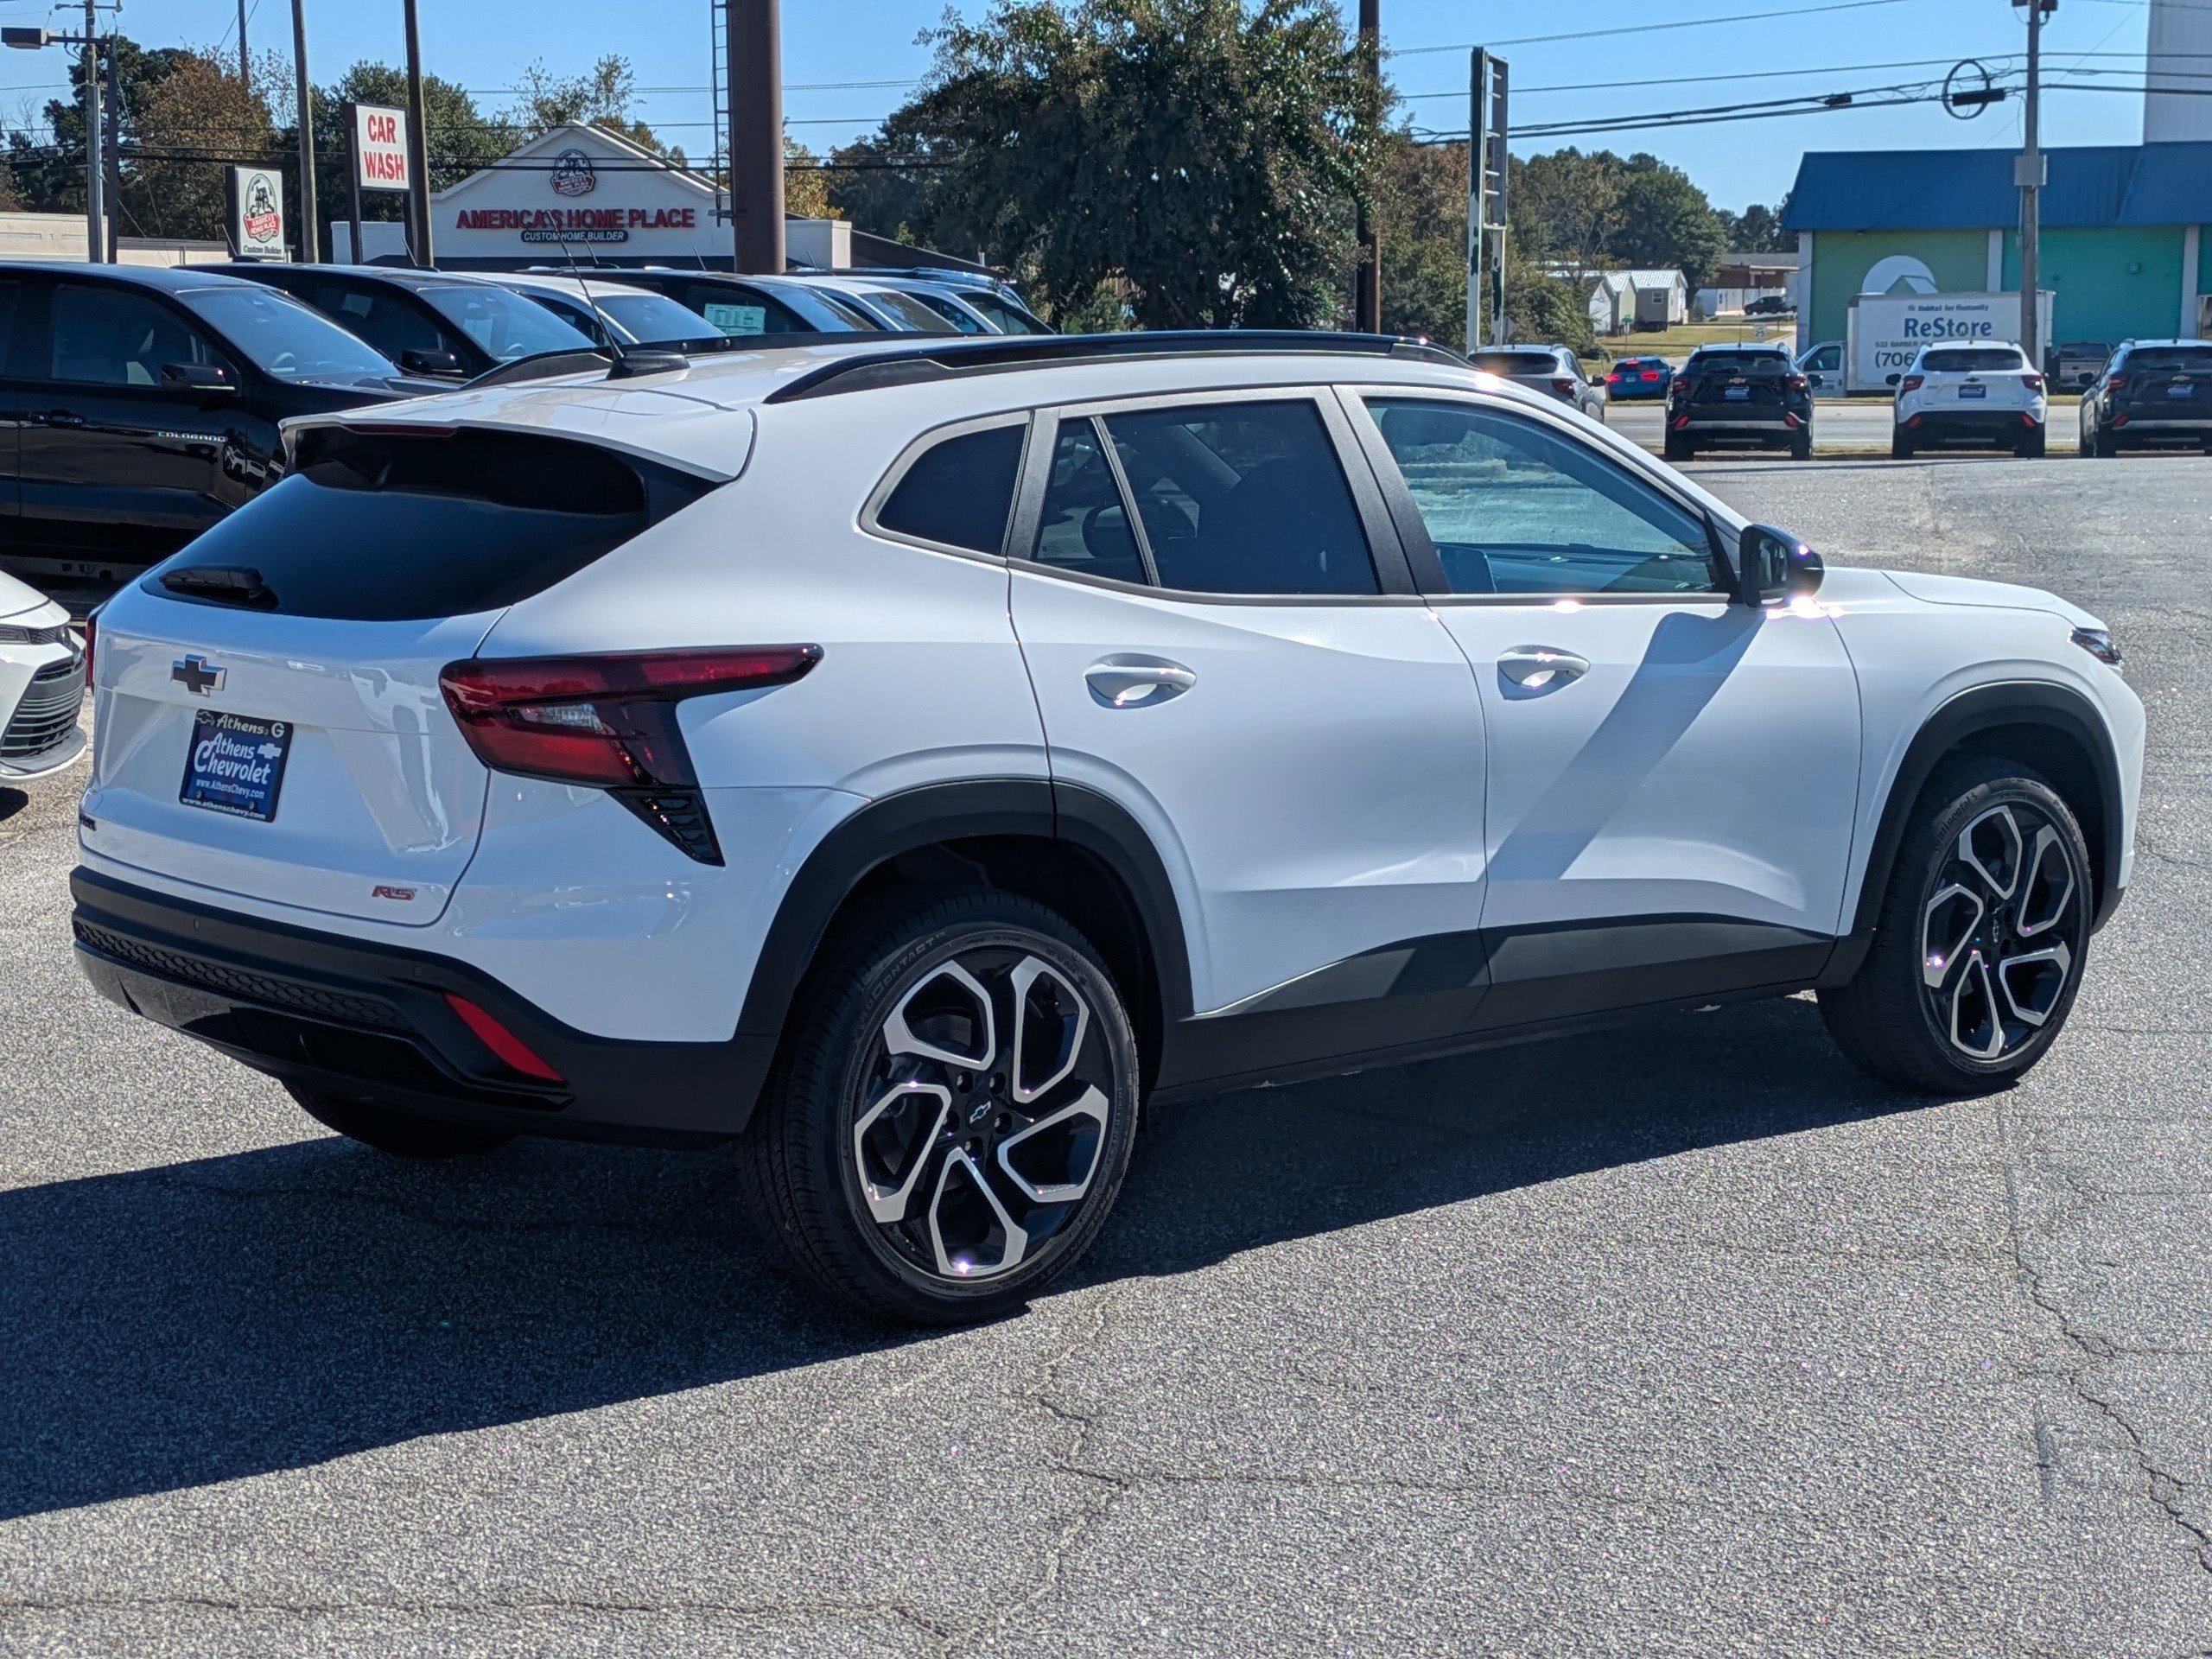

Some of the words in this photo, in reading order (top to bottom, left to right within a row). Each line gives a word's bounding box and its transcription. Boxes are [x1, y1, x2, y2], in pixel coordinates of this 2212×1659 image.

[367, 114, 397, 143] CAR
[363, 150, 405, 181] WASH
[456, 209, 563, 229] AMERICA'S
[567, 208, 626, 228] HOME
[628, 208, 696, 228] PLACE
[524, 231, 560, 242] CUSTOM
[562, 231, 586, 242] HOME
[588, 231, 625, 241] BUILDER
[1904, 317, 1992, 338] ReStore
[1875, 351, 1916, 368] (706
[157, 431, 226, 442] COLORADO
[204, 732, 255, 760] Athens
[194, 740, 271, 785] Chevrolet
[195, 779, 265, 799] www.AthensChevy.com
[372, 885, 417, 900] RS
